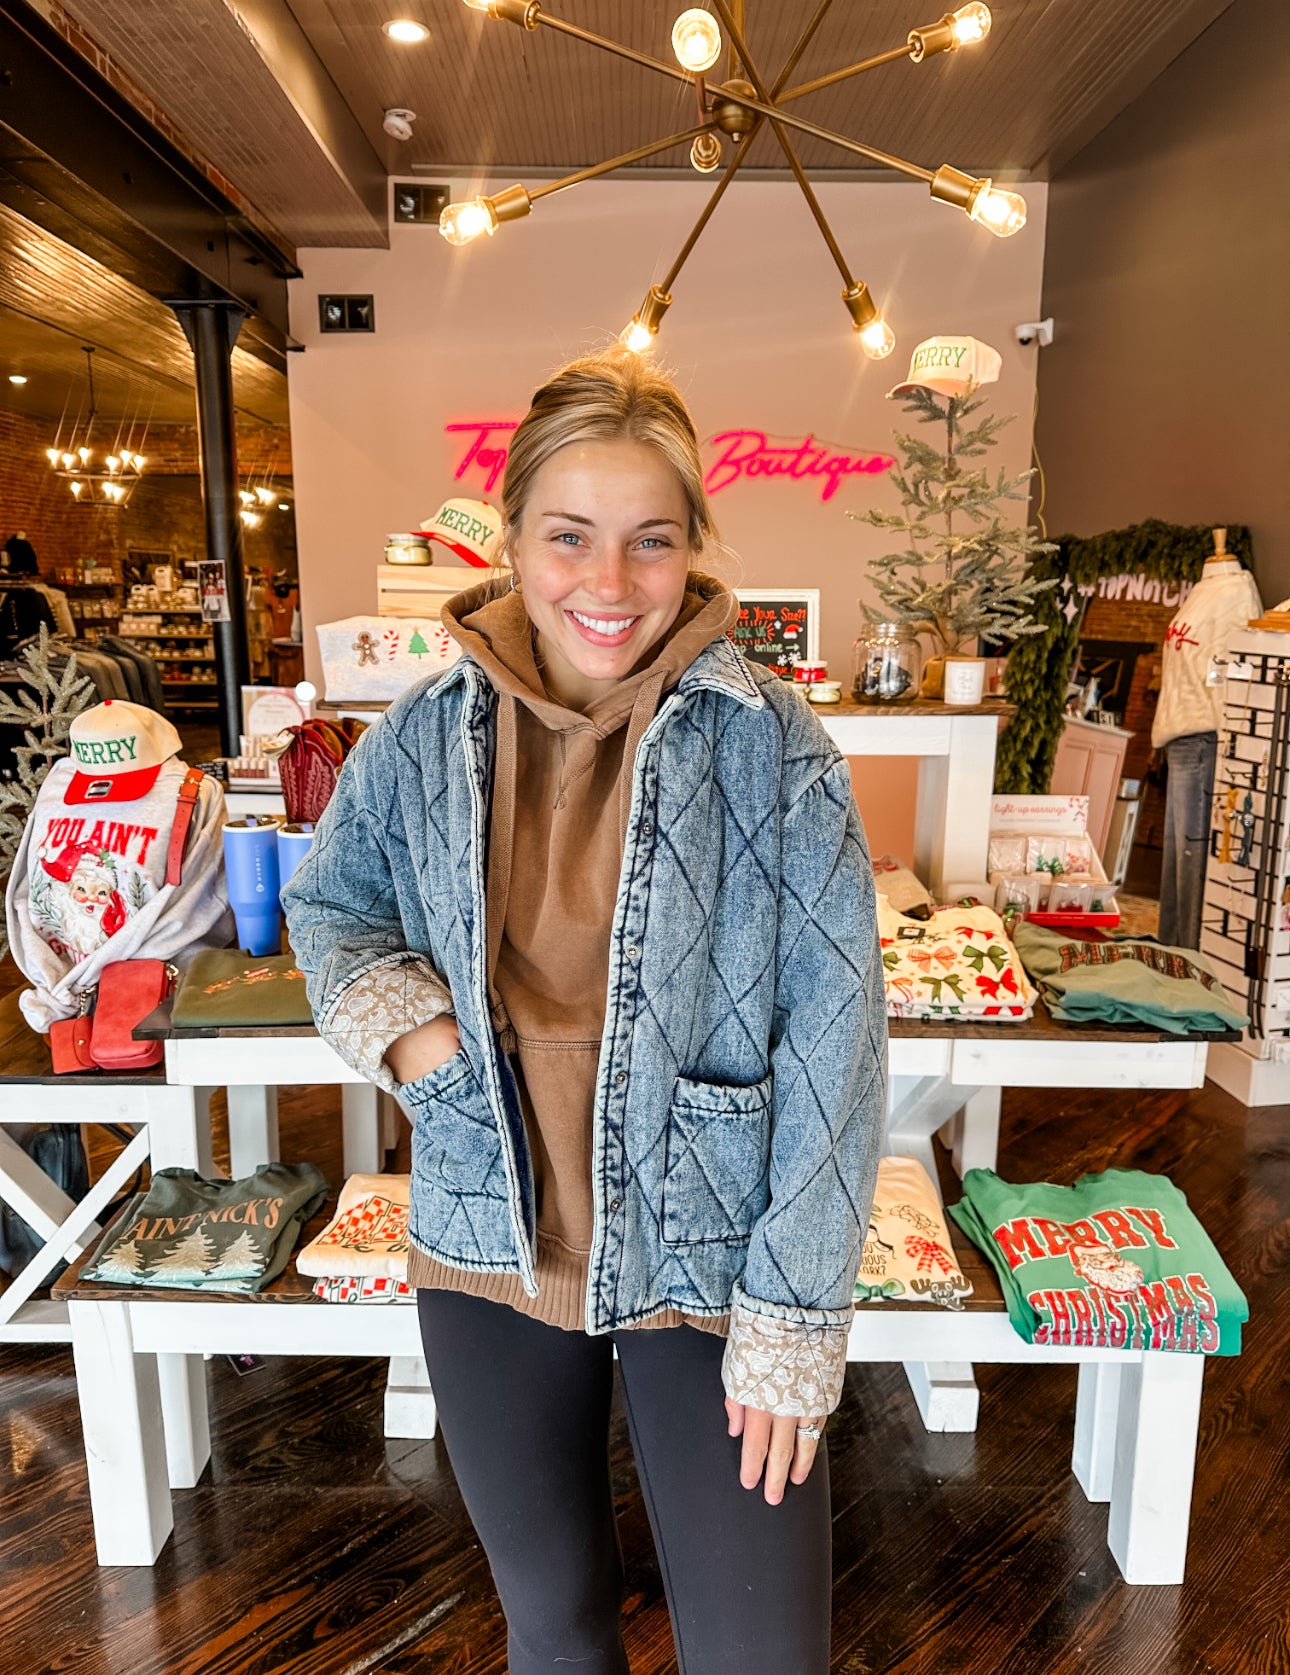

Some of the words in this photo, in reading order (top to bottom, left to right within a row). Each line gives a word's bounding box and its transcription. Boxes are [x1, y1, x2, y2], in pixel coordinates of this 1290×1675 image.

[704, 430, 896, 501] Boutique
[435, 506, 495, 547] MERRY
[41, 817, 86, 851] YOU
[88, 819, 159, 867] AIN'T
[202, 1197, 284, 1230] NICK'S
[992, 1206, 1180, 1272] MERRY
[1027, 1272, 1219, 1349] CHRISTMAS
